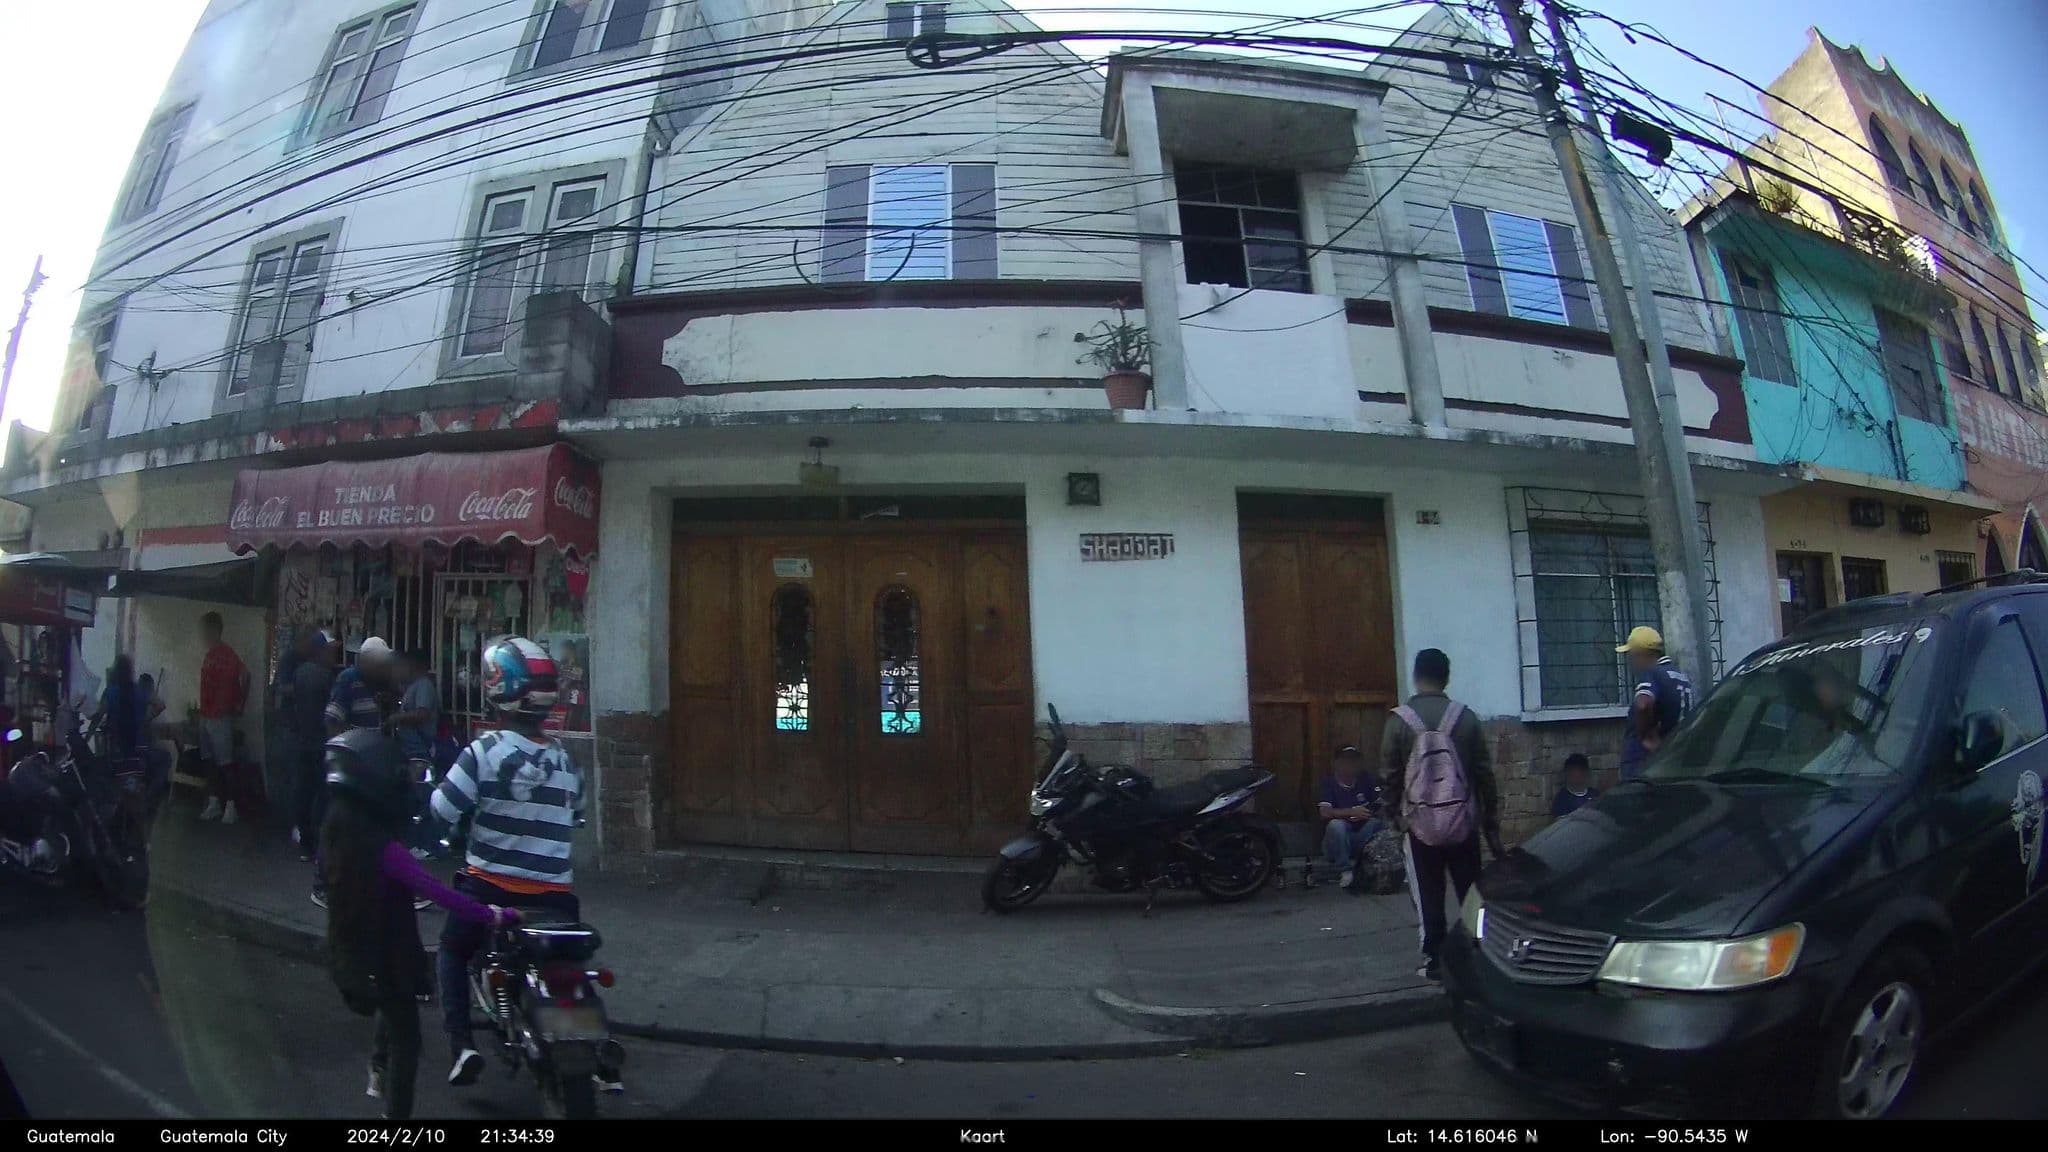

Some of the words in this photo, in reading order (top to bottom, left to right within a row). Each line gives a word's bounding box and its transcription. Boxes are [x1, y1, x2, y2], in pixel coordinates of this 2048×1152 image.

[335, 484, 396, 504] TIENDA
[297, 511, 314, 528] EL
[318, 508, 363, 527] BUEN
[367, 504, 435, 524] PRECIO
